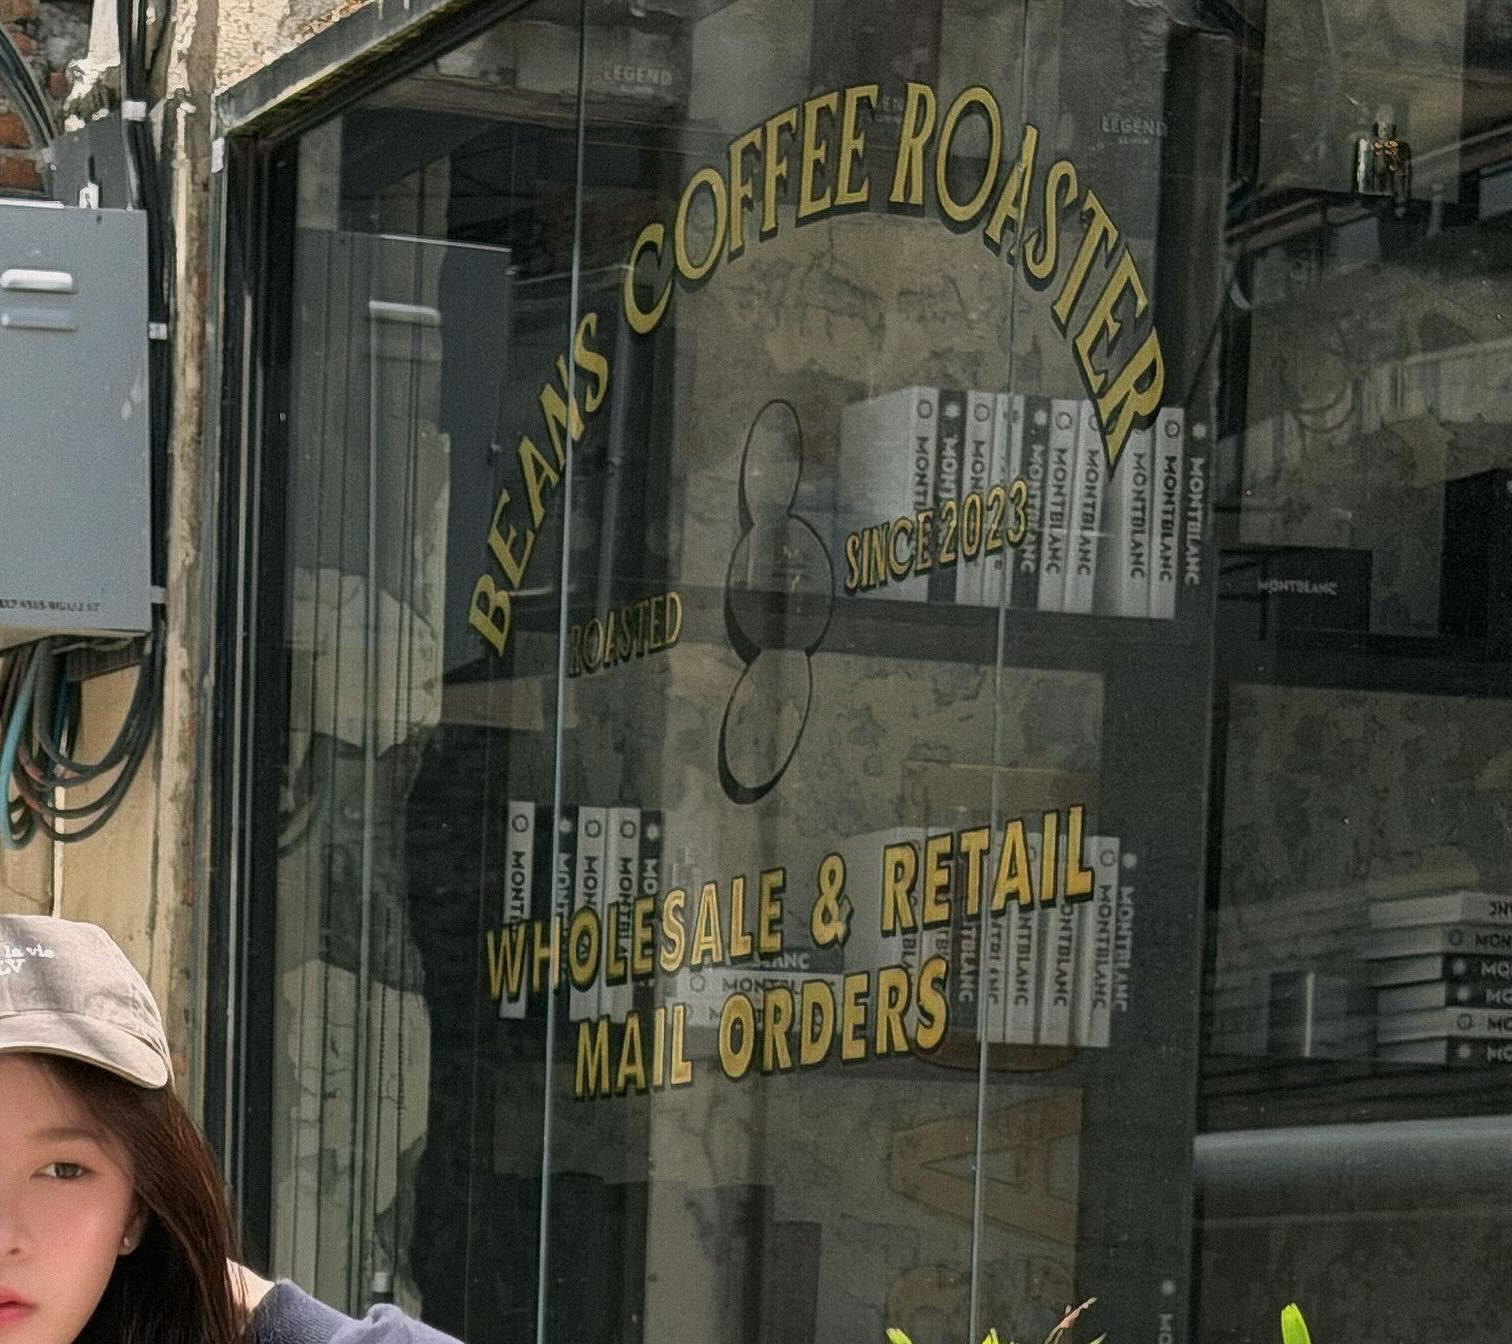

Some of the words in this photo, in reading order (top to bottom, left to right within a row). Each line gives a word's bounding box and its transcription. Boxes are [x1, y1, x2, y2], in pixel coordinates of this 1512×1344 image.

[468, 313, 609, 657] BEANS
[623, 83, 880, 335] COFFEE
[890, 81, 1167, 478] ROASTER
[844, 508, 934, 594] SINCE
[938, 479, 1028, 572] 2023
[1045, 448, 1069, 575] MONTBLANC
[1077, 449, 1100, 576] MONTBLANC
[1130, 452, 1148, 580] MONTBLANC
[1159, 456, 1178, 582] MONTBLANC
[568, 591, 682, 678] ROASTED
[487, 866, 786, 1001] WHOLESALE
[811, 853, 853, 949] &
[881, 803, 1095, 938] RETAIL
[1054, 903, 1075, 1007] ONTBLANC
[1093, 884, 1112, 1009] MONTBLANC
[574, 1004, 693, 1102] MAIL
[719, 955, 949, 1081] ORDERS
